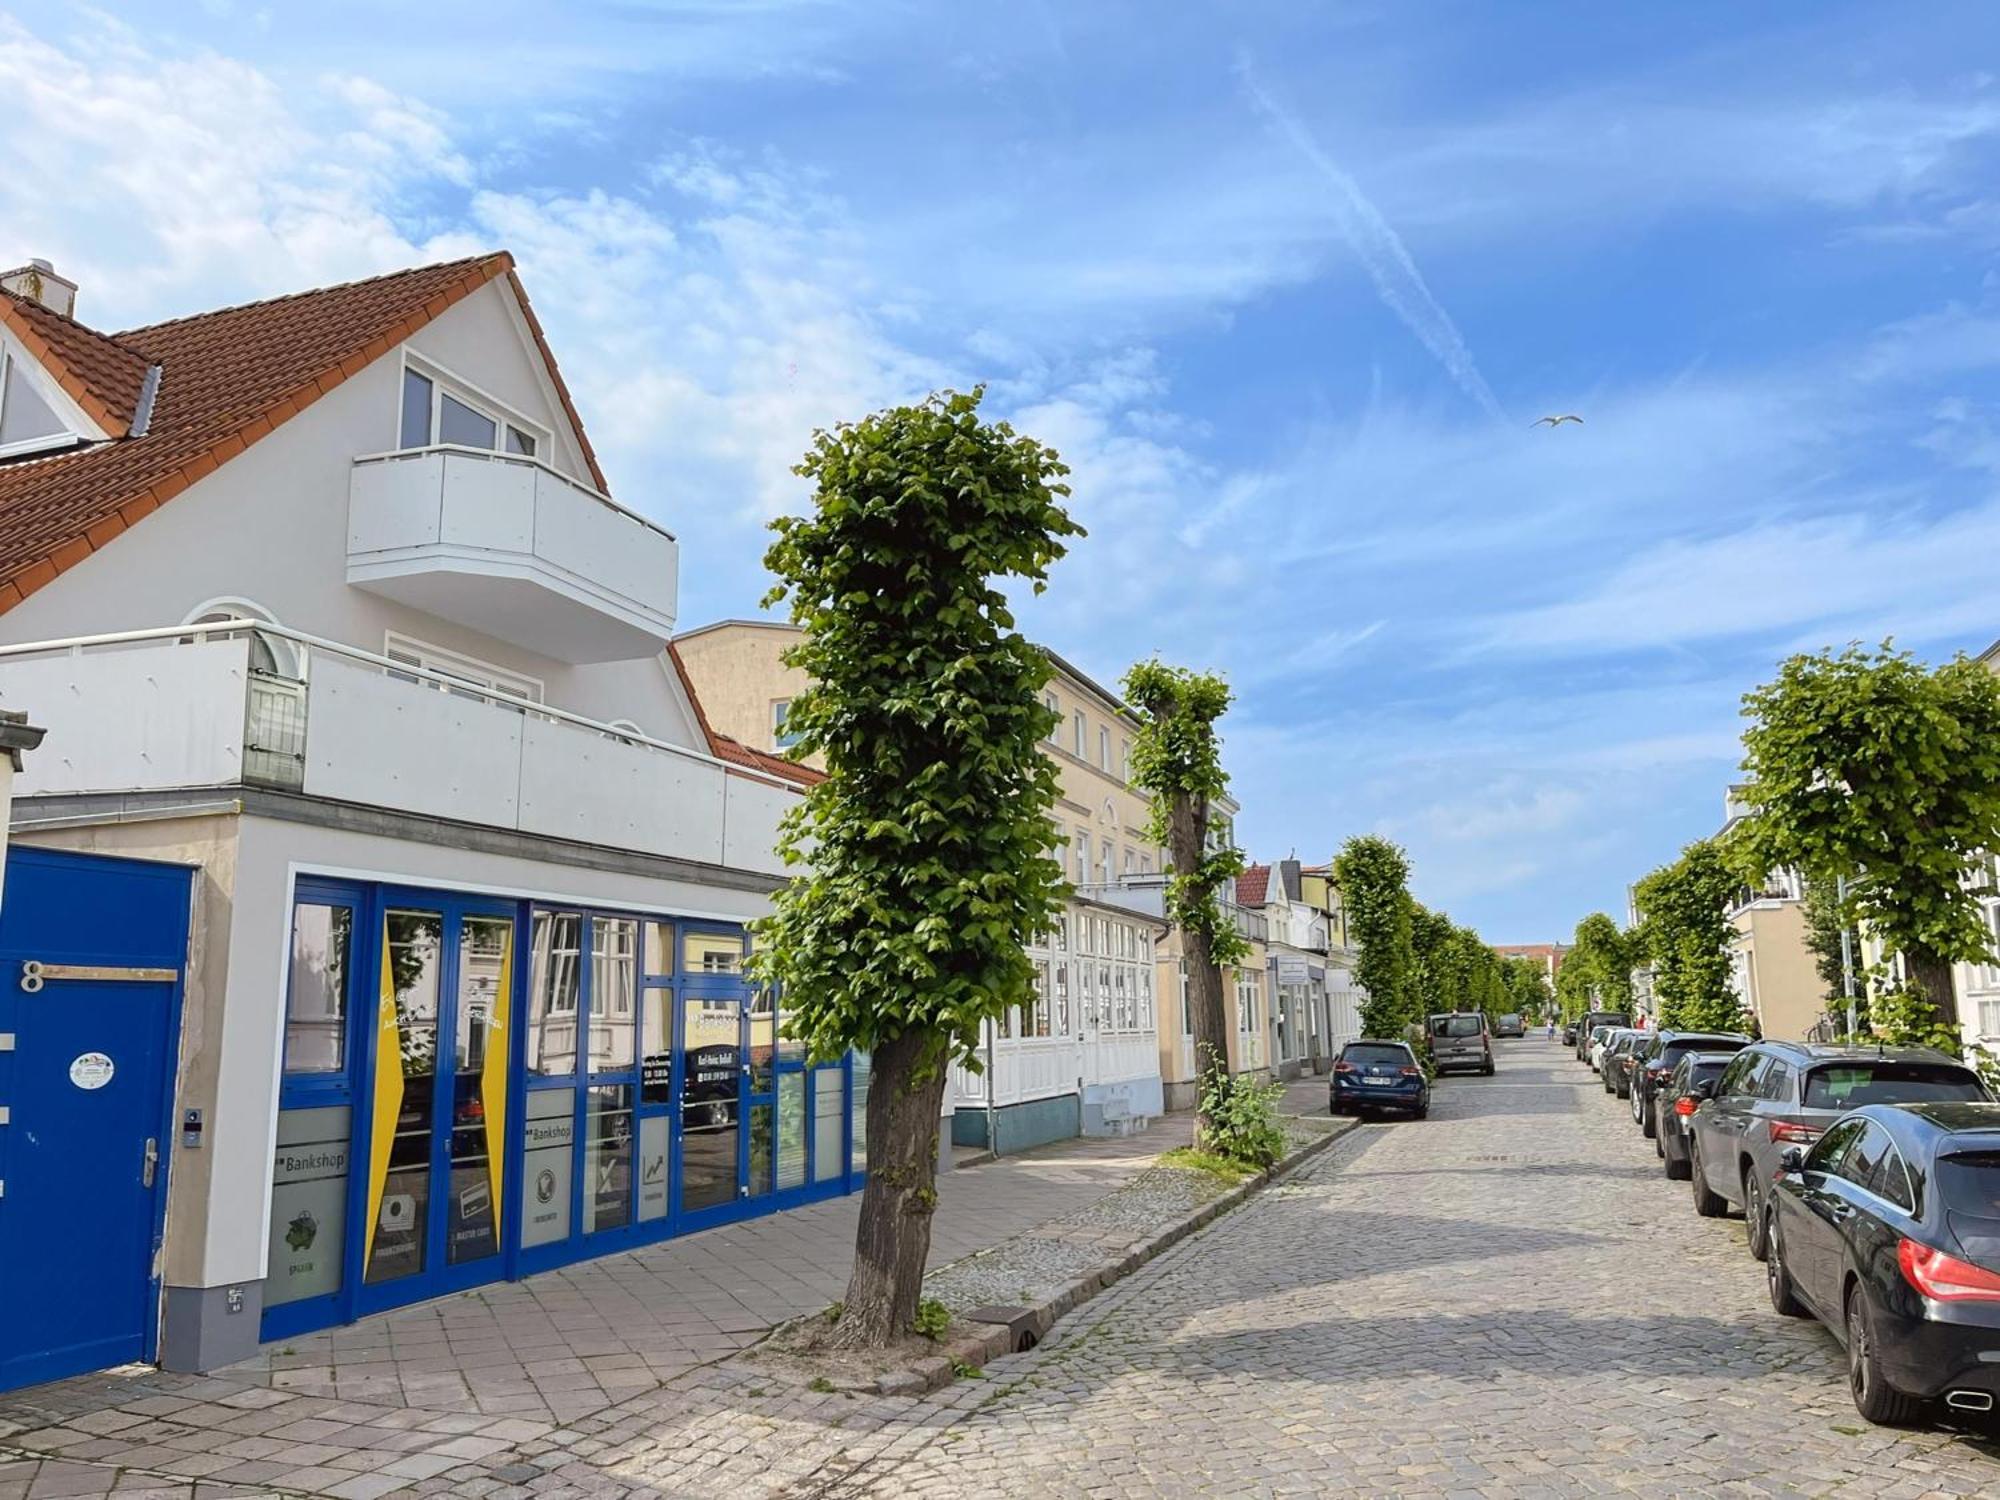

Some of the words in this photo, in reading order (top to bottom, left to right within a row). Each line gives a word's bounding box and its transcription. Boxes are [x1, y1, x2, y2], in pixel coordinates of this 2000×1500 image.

[21, 961, 44, 992] 8
[533, 1126, 570, 1141] Bankshop
[286, 1152, 344, 1171] Bankshop
